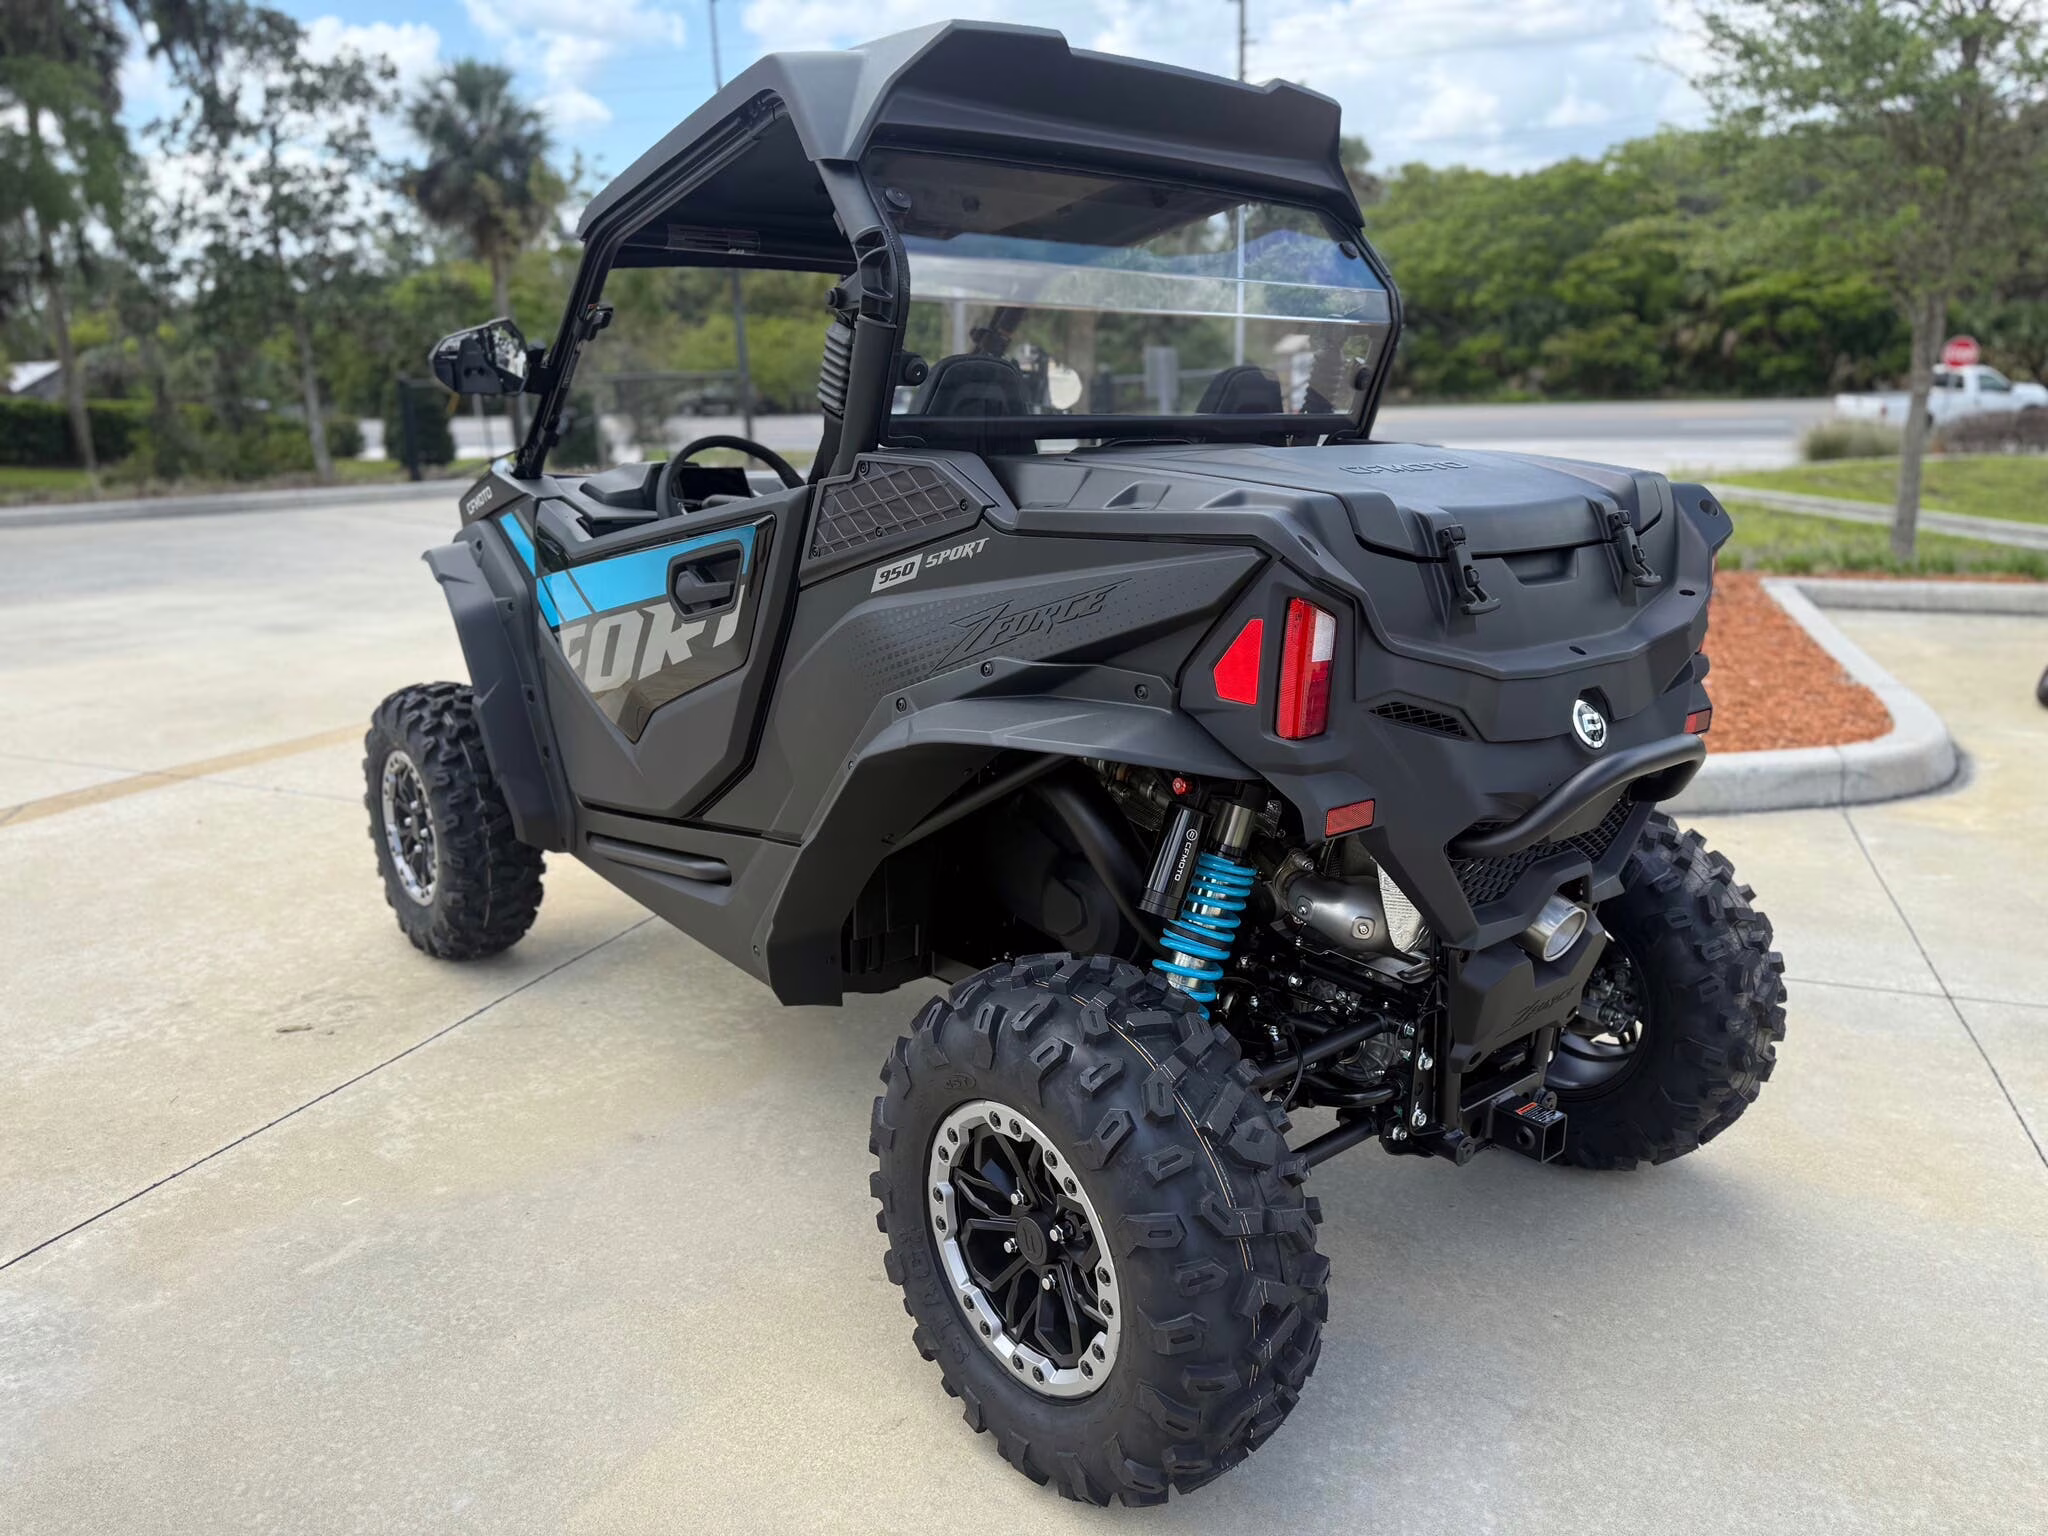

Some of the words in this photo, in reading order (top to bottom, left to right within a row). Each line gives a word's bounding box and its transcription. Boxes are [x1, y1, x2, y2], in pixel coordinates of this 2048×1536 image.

[878, 562, 916, 585] 950
[925, 538, 990, 568] SPORT
[1175, 842, 1192, 882] CFMOTO
